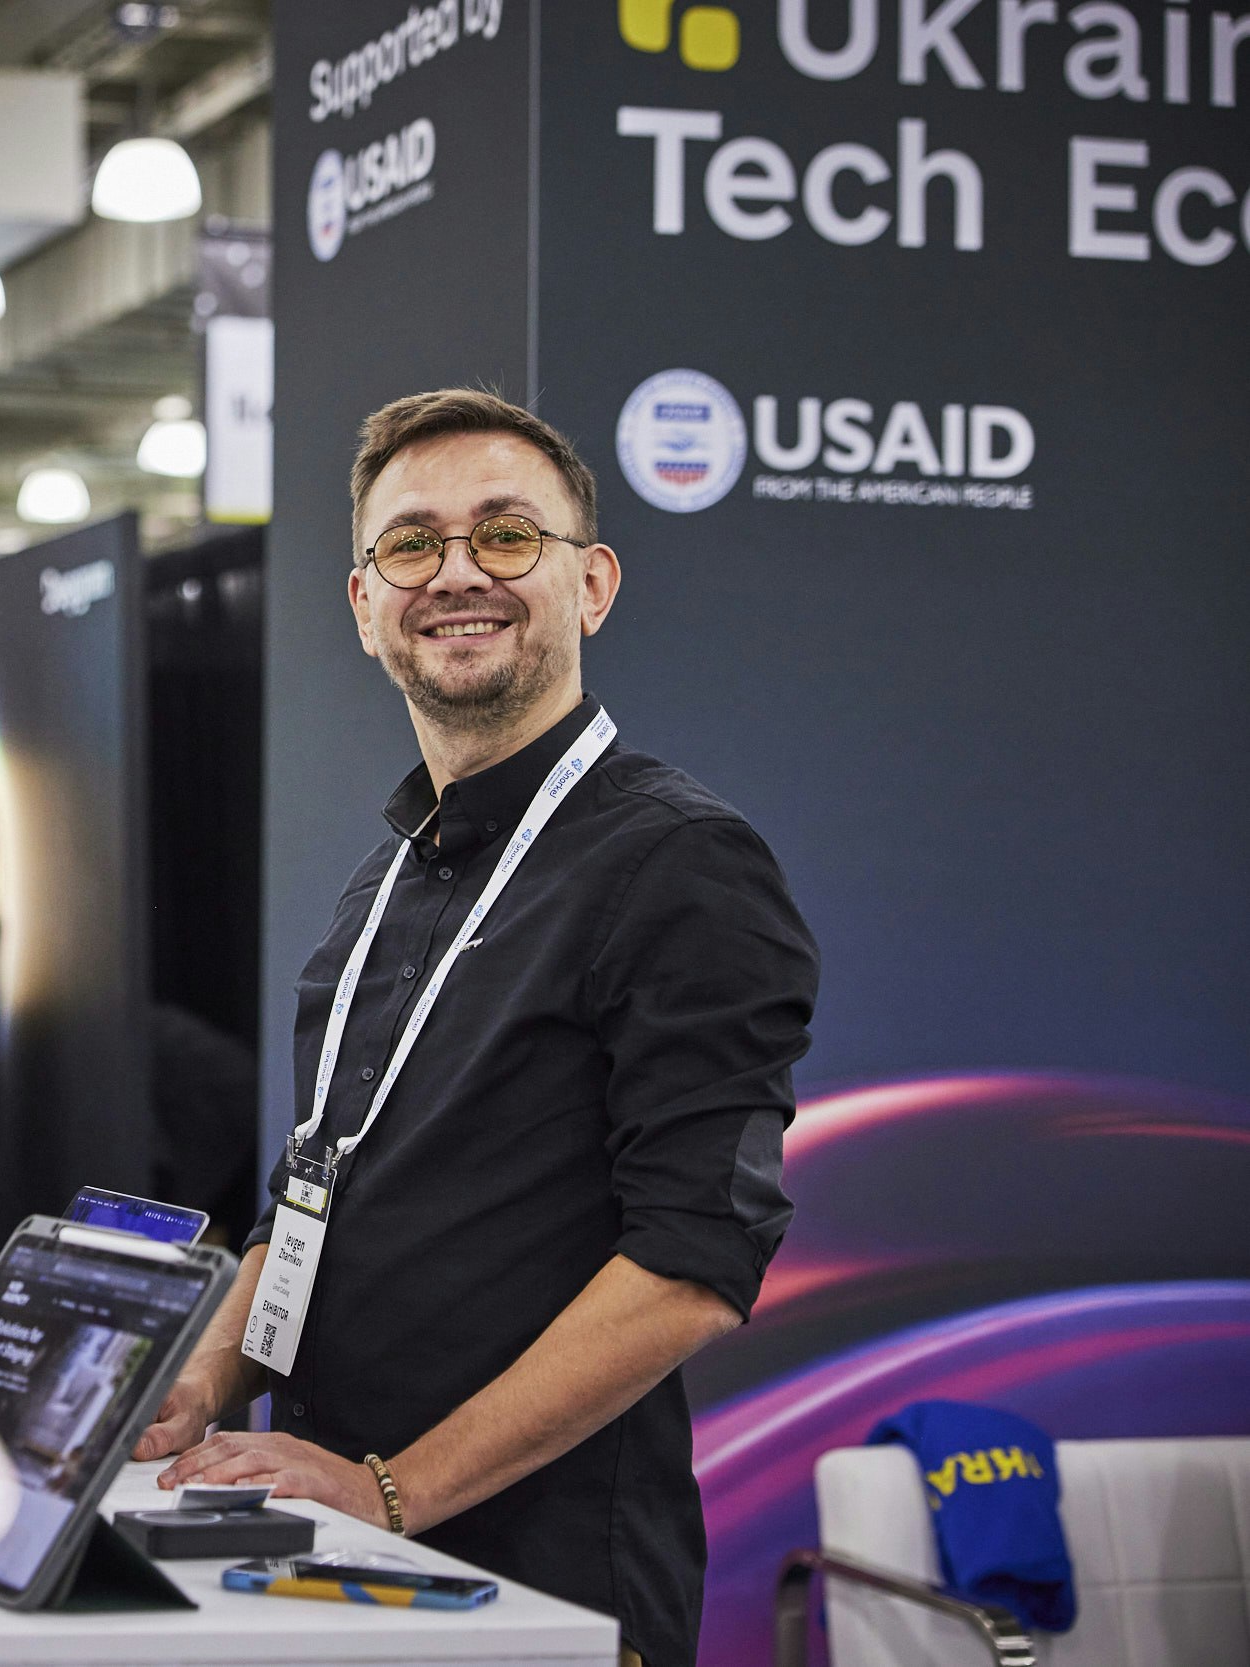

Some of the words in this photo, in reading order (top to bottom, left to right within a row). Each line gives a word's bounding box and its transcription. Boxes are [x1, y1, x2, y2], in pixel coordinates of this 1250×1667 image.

[308, 0, 459, 122] Supported
[345, 117, 436, 213] USAID
[617, 106, 985, 251] Tech
[1068, 135, 1250, 266] Ec
[754, 394, 1036, 479] USAID
[550, 769, 575, 798] Snorkel
[502, 842, 524, 873] Snorkel
[340, 968, 354, 1000] Snorkel
[263, 1300, 289, 1321] EXHIBITOR
